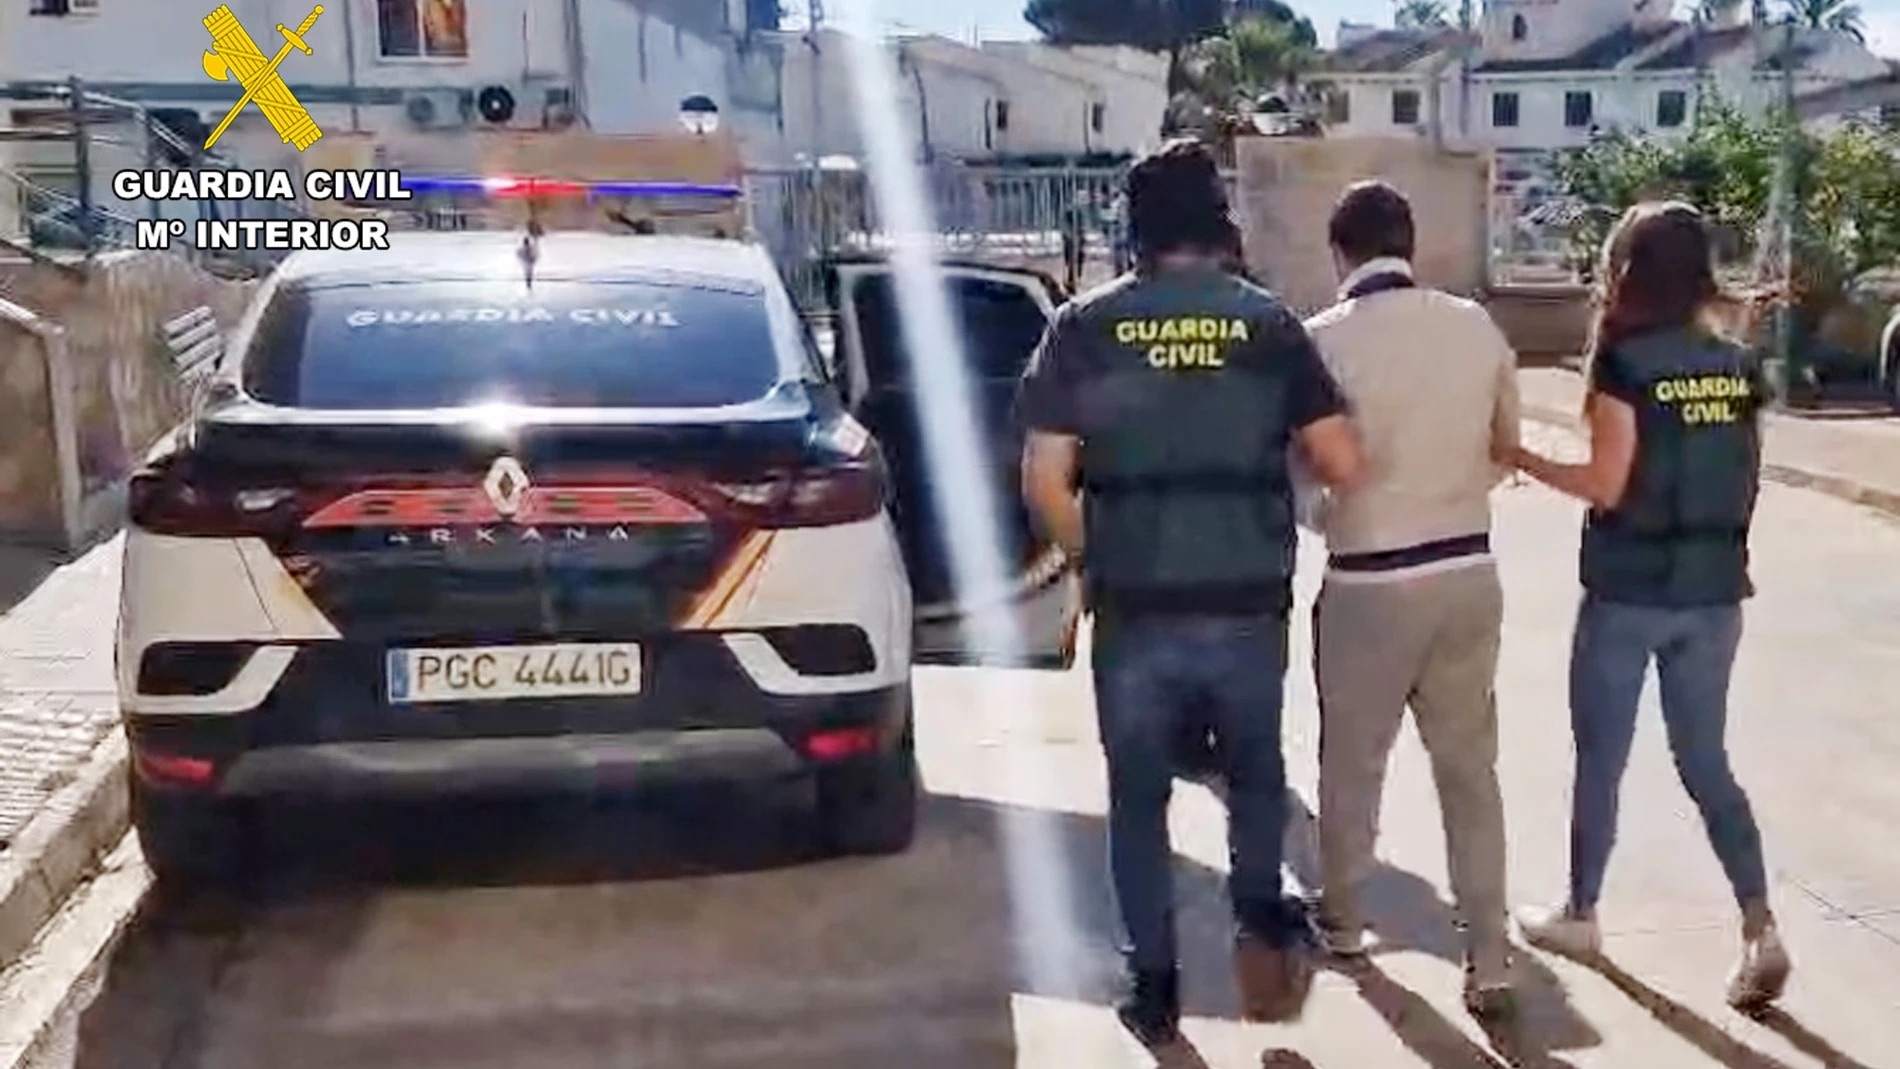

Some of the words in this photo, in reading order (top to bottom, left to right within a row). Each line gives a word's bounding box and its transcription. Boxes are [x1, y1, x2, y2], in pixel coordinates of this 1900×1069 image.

[346, 307, 555, 327] GUARDIA
[568, 306, 681, 327] CIVIL
[1115, 317, 1250, 343] GUARDIA
[1148, 342, 1226, 368] CIVIL
[1682, 401, 1737, 424] CIVIL
[417, 653, 498, 691] PGC
